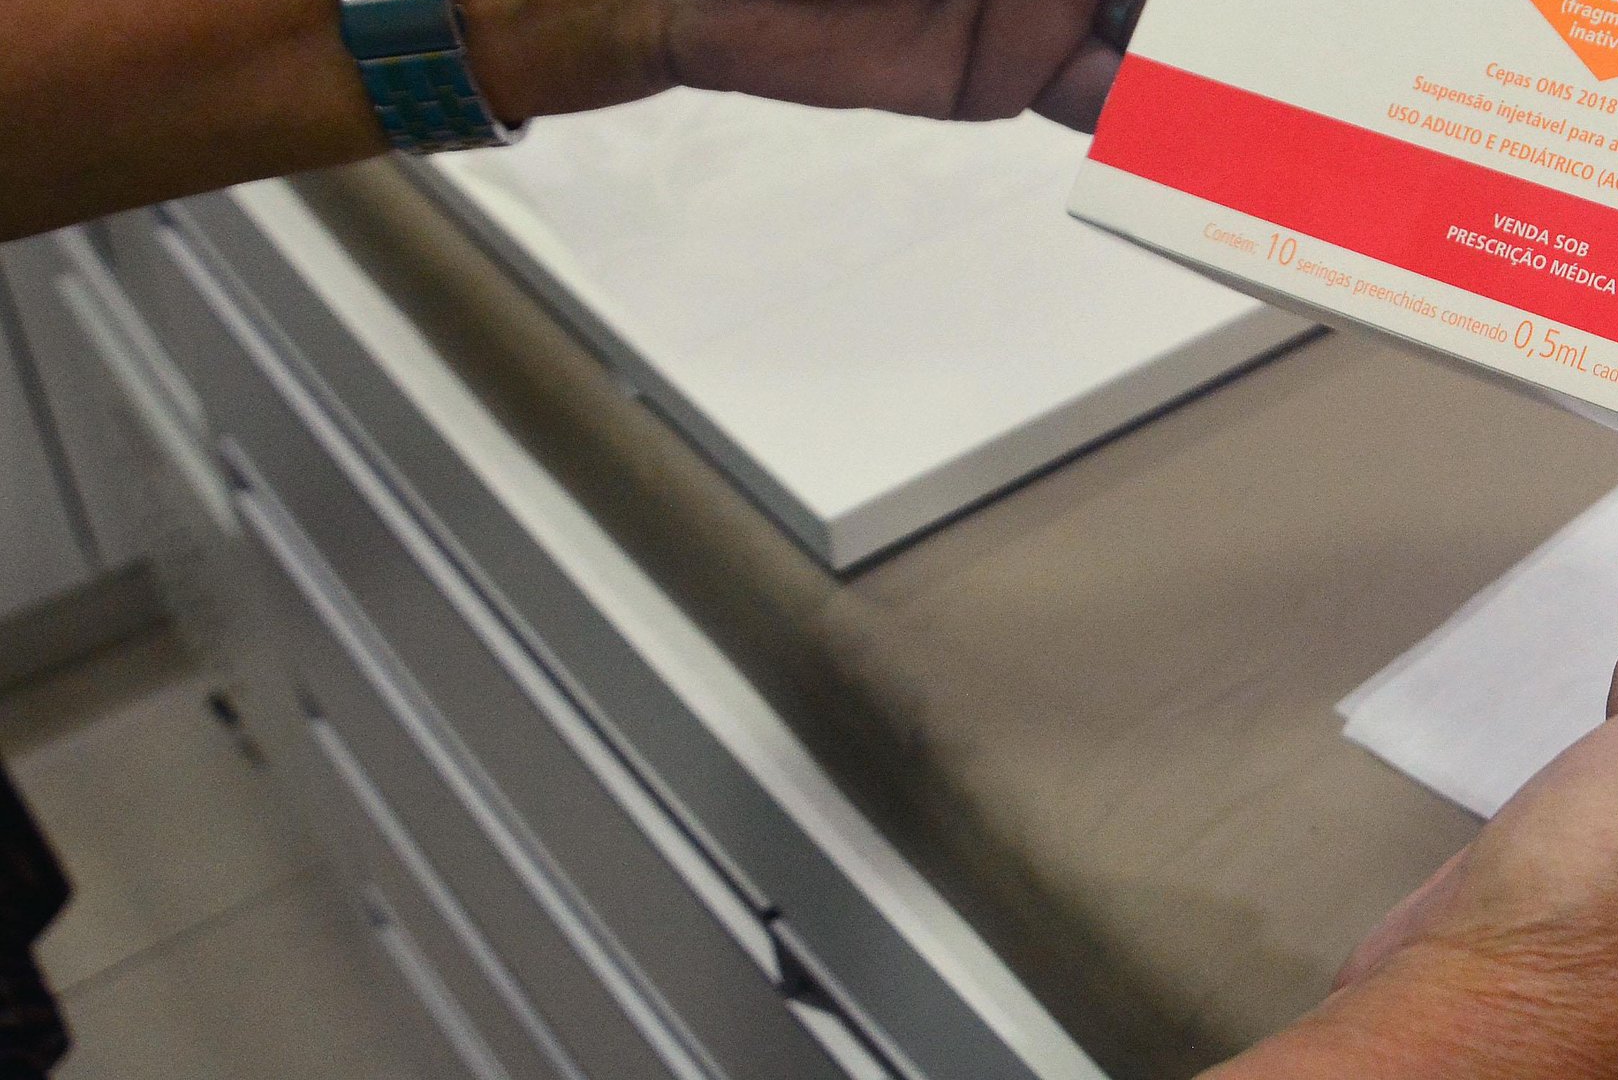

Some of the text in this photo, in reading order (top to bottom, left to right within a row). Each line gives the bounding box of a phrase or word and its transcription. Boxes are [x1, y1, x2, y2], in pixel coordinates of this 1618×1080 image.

[1413, 75, 1493, 112] Suspensão
[1497, 99, 1566, 135] injetável
[1567, 123, 1605, 147] para
[1486, 62, 1531, 90] Cepas
[1537, 78, 1573, 101] OMS
[1577, 89, 1618, 114] 2018
[1387, 103, 1420, 125] USO
[1421, 116, 1482, 145] ADULTO
[1485, 133, 1497, 149] E
[1500, 138, 1596, 182] PEDIÁTRICO
[1446, 225, 1617, 294] PRESCRIÇÃO MÉDICA
[1493, 213, 1590, 258] VENDA SOB
[1204, 222, 1258, 254] Contém:
[1266, 232, 1297, 266] 10
[1296, 259, 1351, 288] seringas
[1352, 278, 1437, 319] preenchidas
[1441, 309, 1508, 344] contendo
[1513, 320, 1588, 372] 0,5mL
